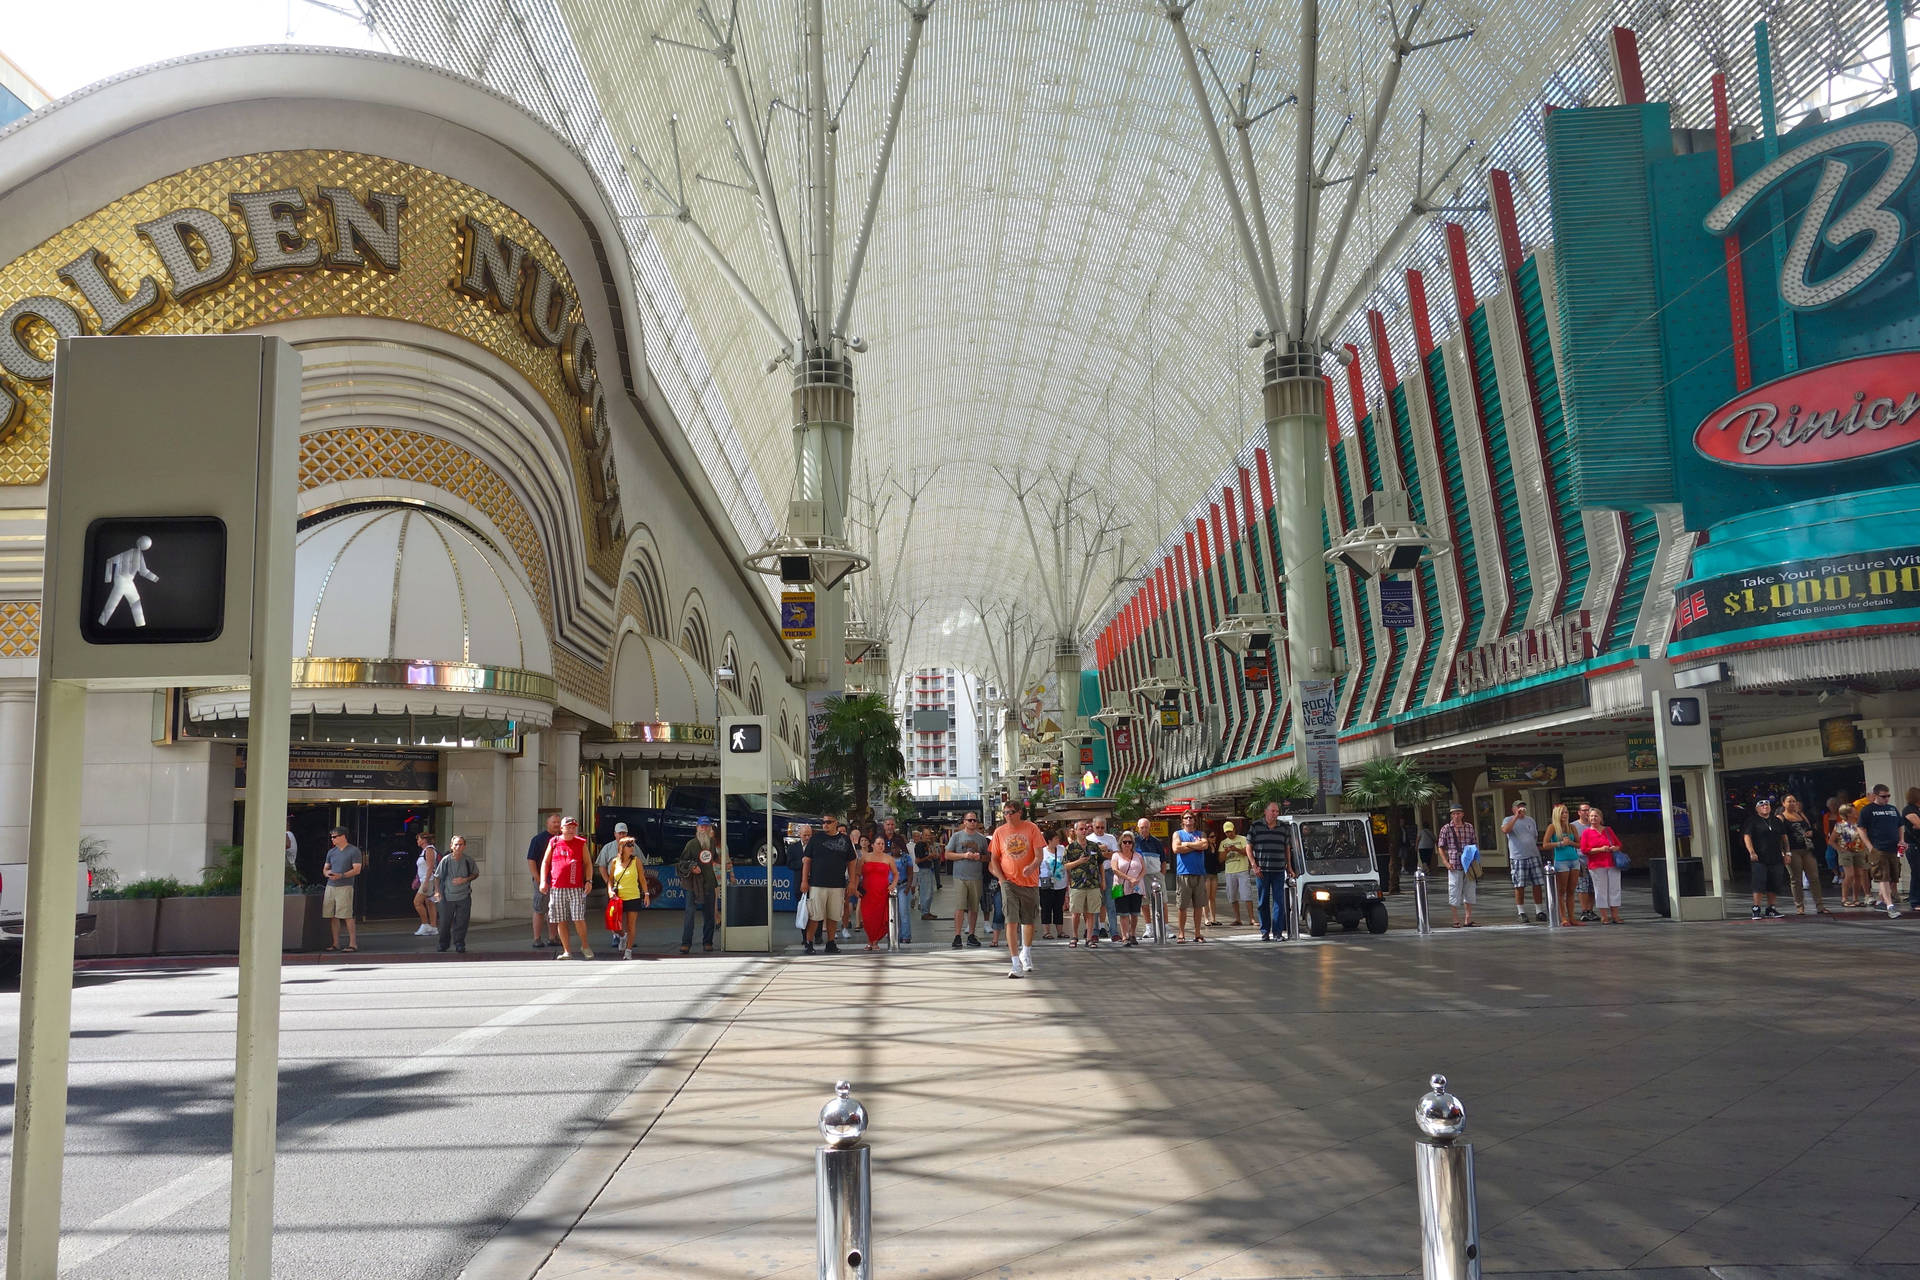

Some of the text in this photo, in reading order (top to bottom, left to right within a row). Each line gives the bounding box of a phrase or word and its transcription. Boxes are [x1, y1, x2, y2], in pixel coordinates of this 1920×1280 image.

[0, 185, 408, 441] OLDEN
[1740, 576, 1774, 588] Take
[1778, 569, 1816, 581] Your
[1821, 560, 1885, 575] Picture
[1792, 607, 1812, 616] Club
[1813, 603, 1847, 613] Binion's
[1862, 598, 1894, 607] details
[1456, 608, 1585, 697] GAMBLING
[1302, 690, 1334, 716] ROCK
[1311, 709, 1322, 717] OF
[1304, 709, 1337, 727] VEGAS
[666, 889, 677, 898] OR
[678, 889, 685, 898] A
